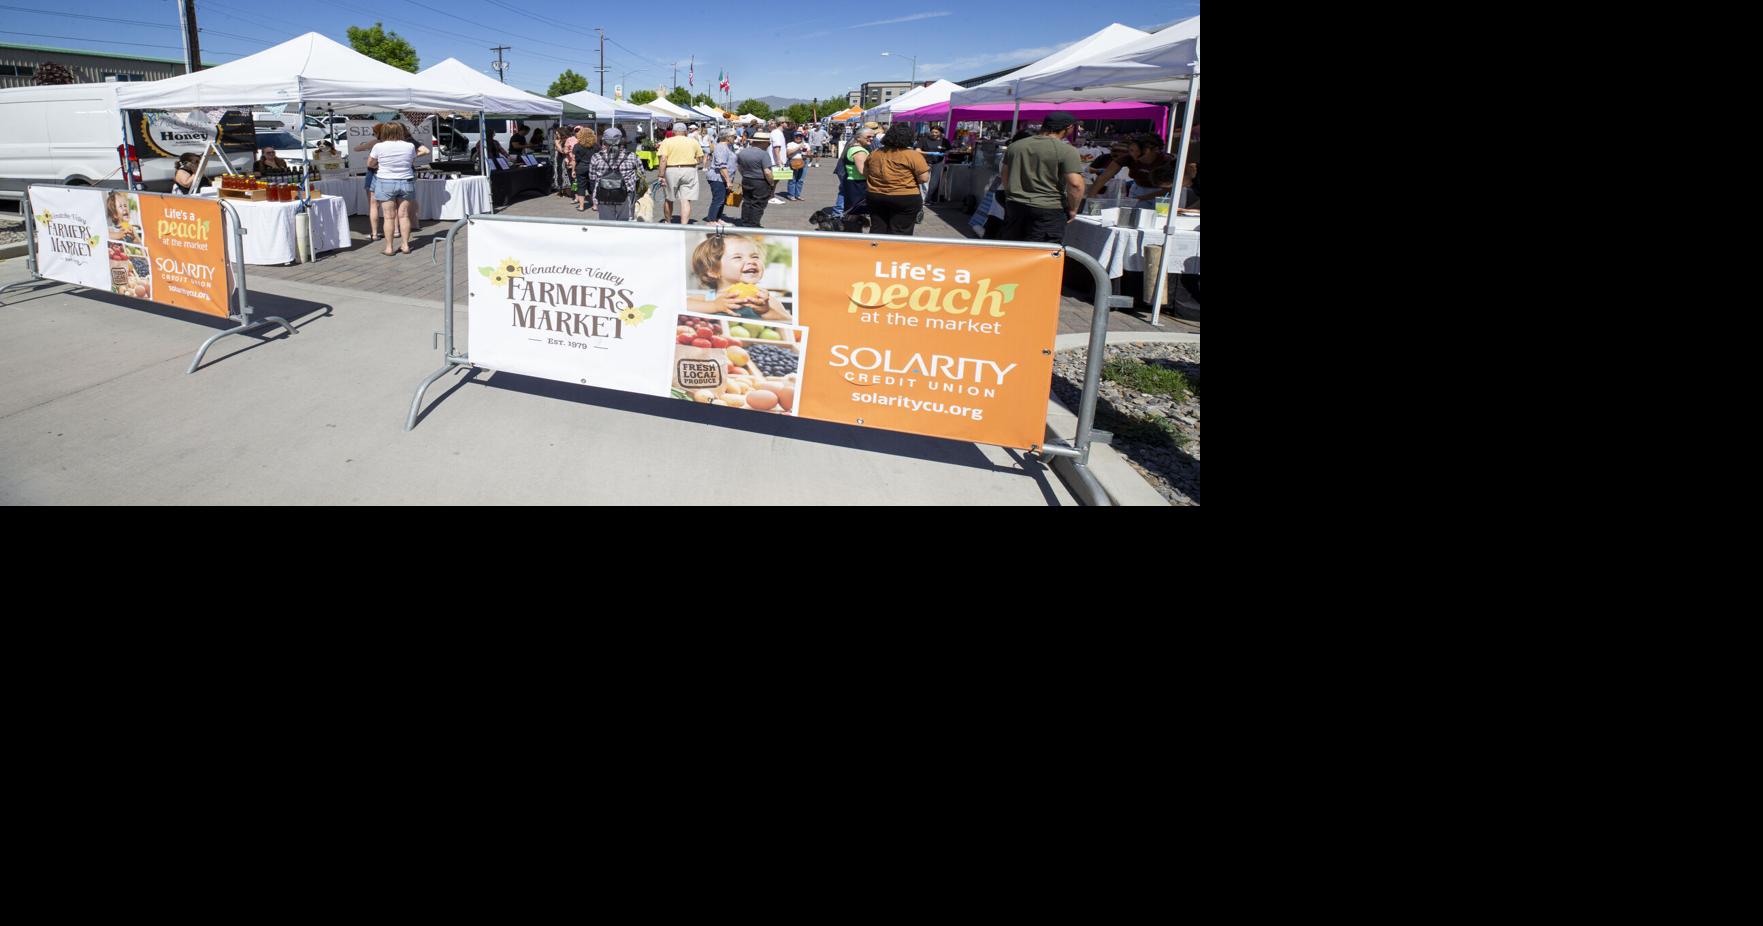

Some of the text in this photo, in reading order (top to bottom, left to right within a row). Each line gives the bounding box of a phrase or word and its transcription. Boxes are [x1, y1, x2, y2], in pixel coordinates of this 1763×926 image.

[160, 131, 209, 142] Honey
[164, 208, 196, 221] Life's a
[48, 220, 92, 240] FARMERS
[157, 218, 208, 240] peach
[51, 237, 92, 257] MARKET
[155, 257, 215, 281] SOLARITY
[516, 263, 625, 287] Wenatchee Valley
[875, 261, 971, 284] Life's a
[506, 275, 635, 314] FARMERS
[847, 278, 1006, 318] peach
[512, 302, 624, 340] MARKET
[860, 311, 1001, 335] at the market
[568, 340, 588, 350] 1979
[683, 363, 716, 372] FRESH
[683, 370, 717, 379] LOCAL
[828, 344, 1017, 385] SOLARITY
[844, 371, 996, 399] CREDIT UNION
[851, 391, 984, 421] solaritycu.org
